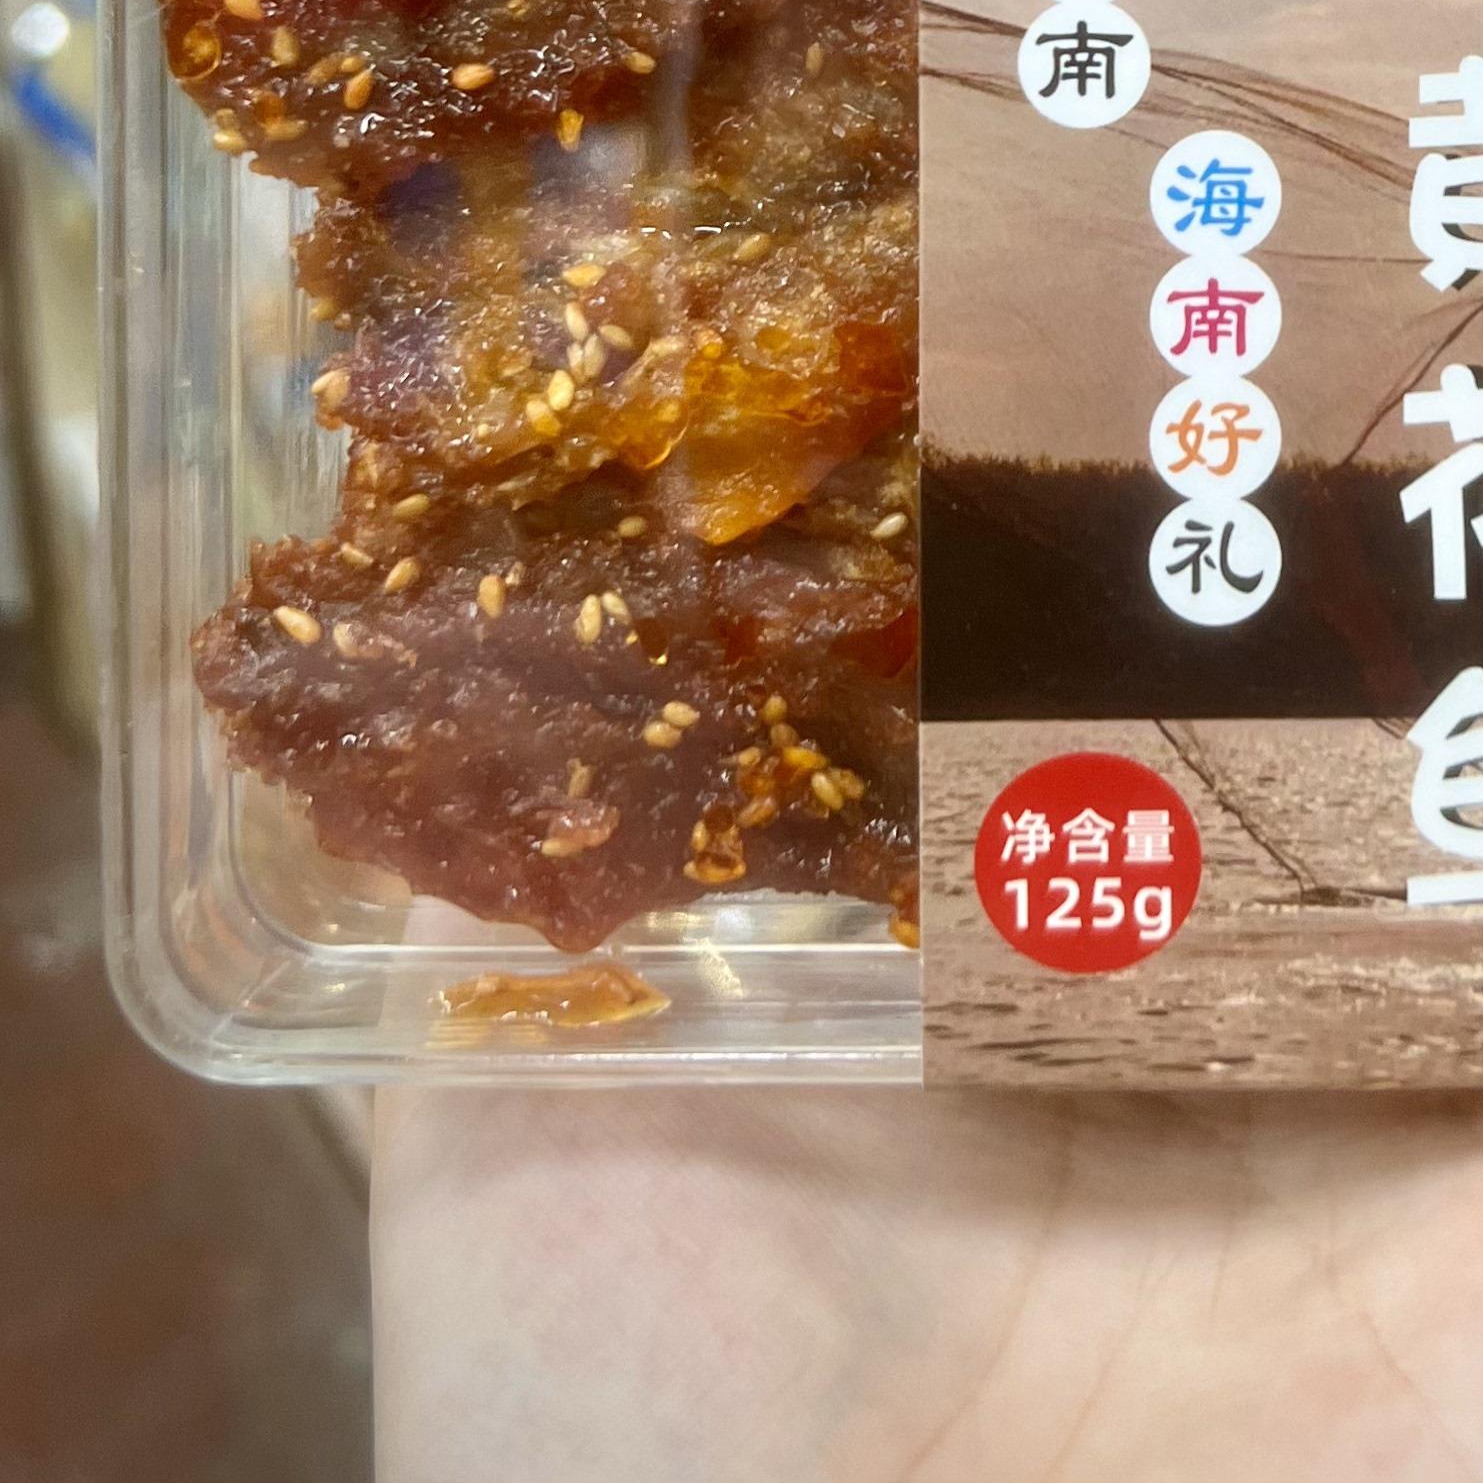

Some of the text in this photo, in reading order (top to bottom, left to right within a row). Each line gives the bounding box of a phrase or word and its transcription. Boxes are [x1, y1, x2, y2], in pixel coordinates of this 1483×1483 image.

[1165, 158, 1265, 595] 海南好礼
[1001, 807, 1175, 865] 净含量
[1004, 876, 1173, 942] 125g
